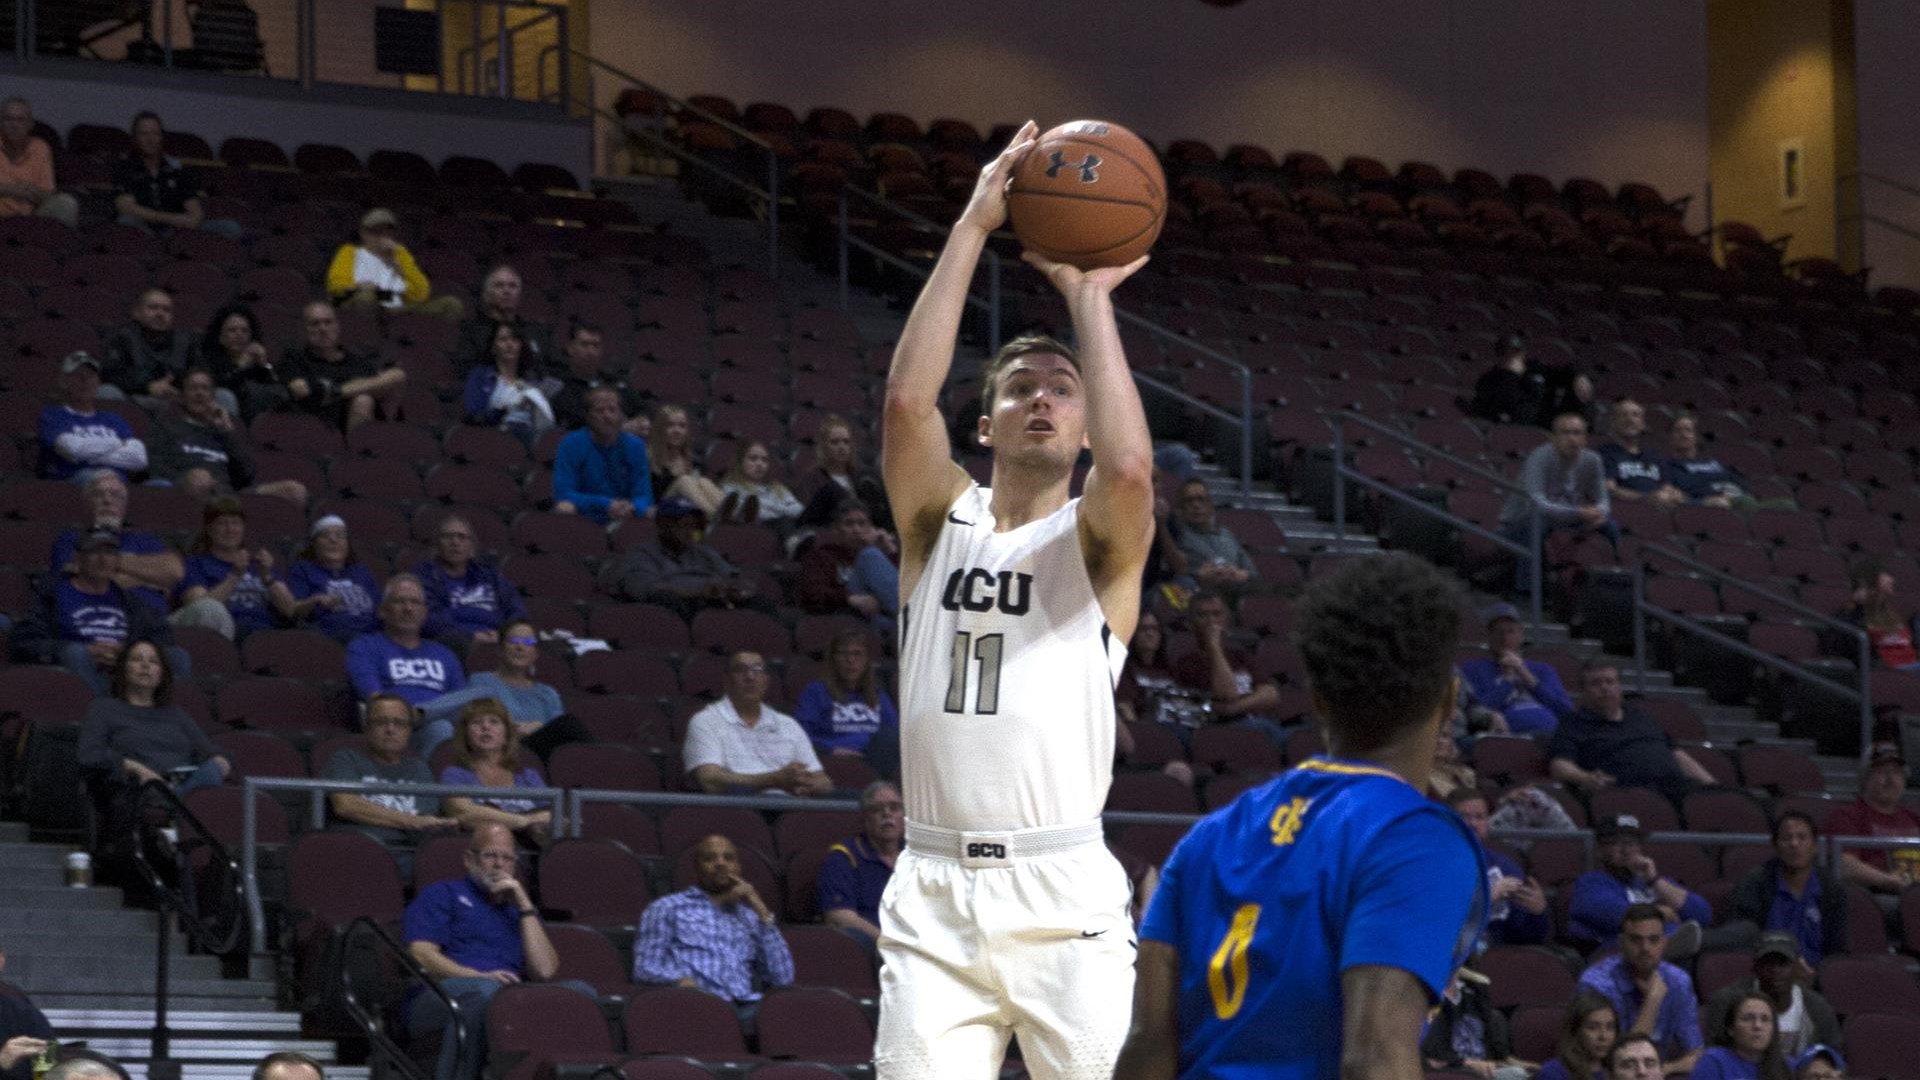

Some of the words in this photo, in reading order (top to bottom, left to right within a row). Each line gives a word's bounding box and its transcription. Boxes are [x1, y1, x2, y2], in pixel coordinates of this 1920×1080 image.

[389, 658, 446, 681] GCU
[944, 630, 1004, 715] 11
[967, 842, 1006, 859] GCU
[1208, 902, 1262, 1020] 0
